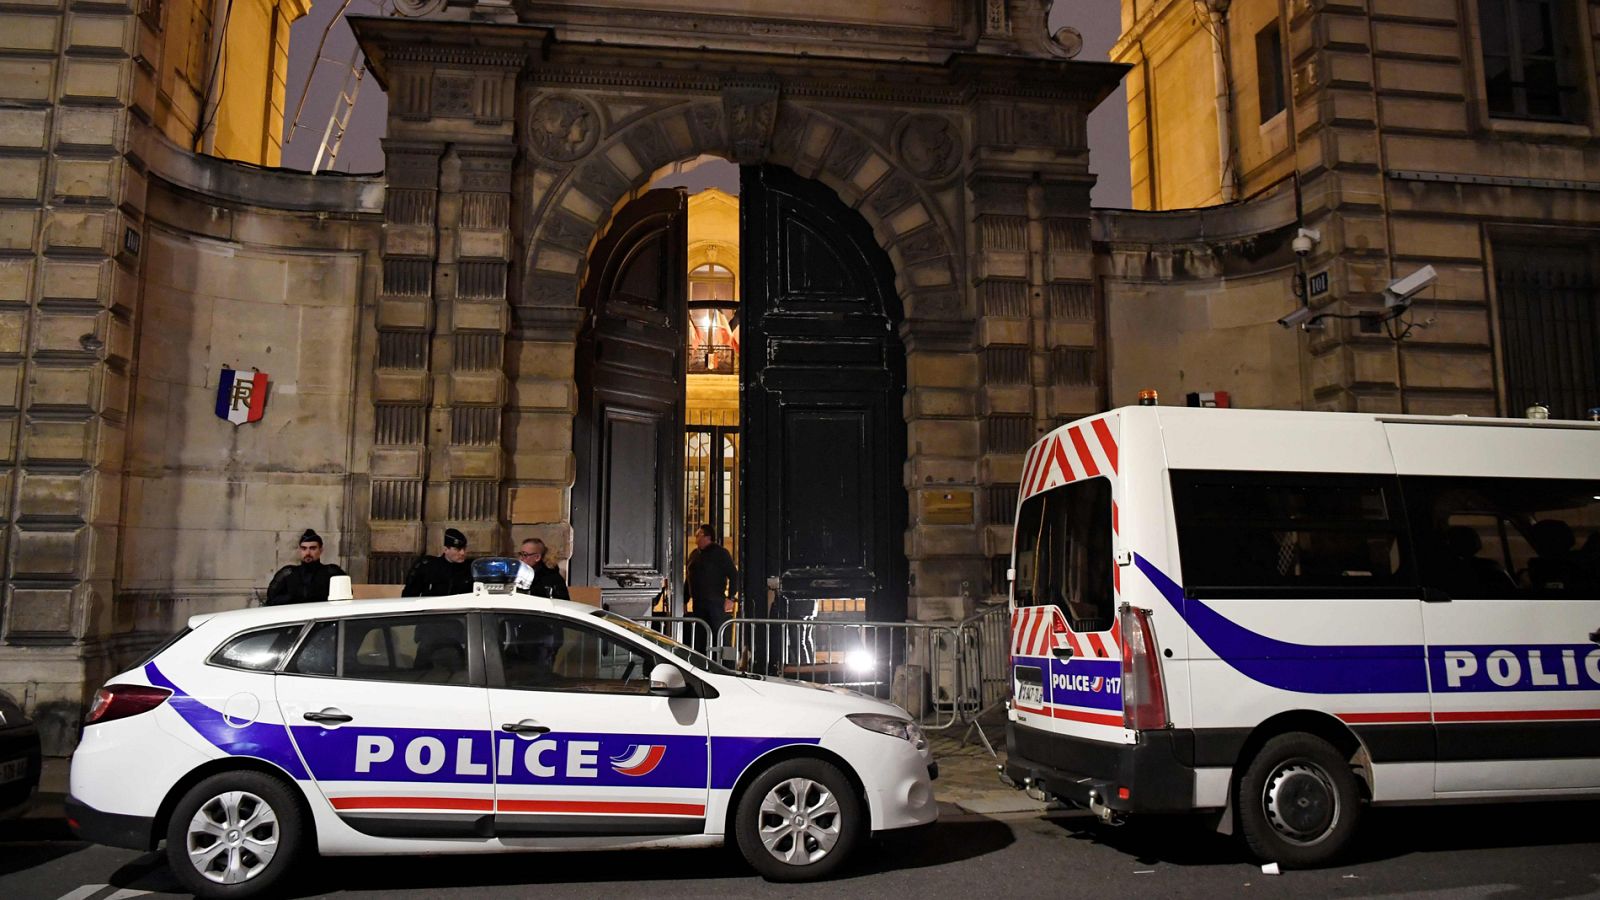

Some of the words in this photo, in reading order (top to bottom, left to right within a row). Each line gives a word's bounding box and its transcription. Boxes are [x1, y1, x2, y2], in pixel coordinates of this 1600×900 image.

[1312, 275, 1325, 294] 101
[1052, 673, 1090, 692] POLICE
[354, 735, 600, 778] POLICE
